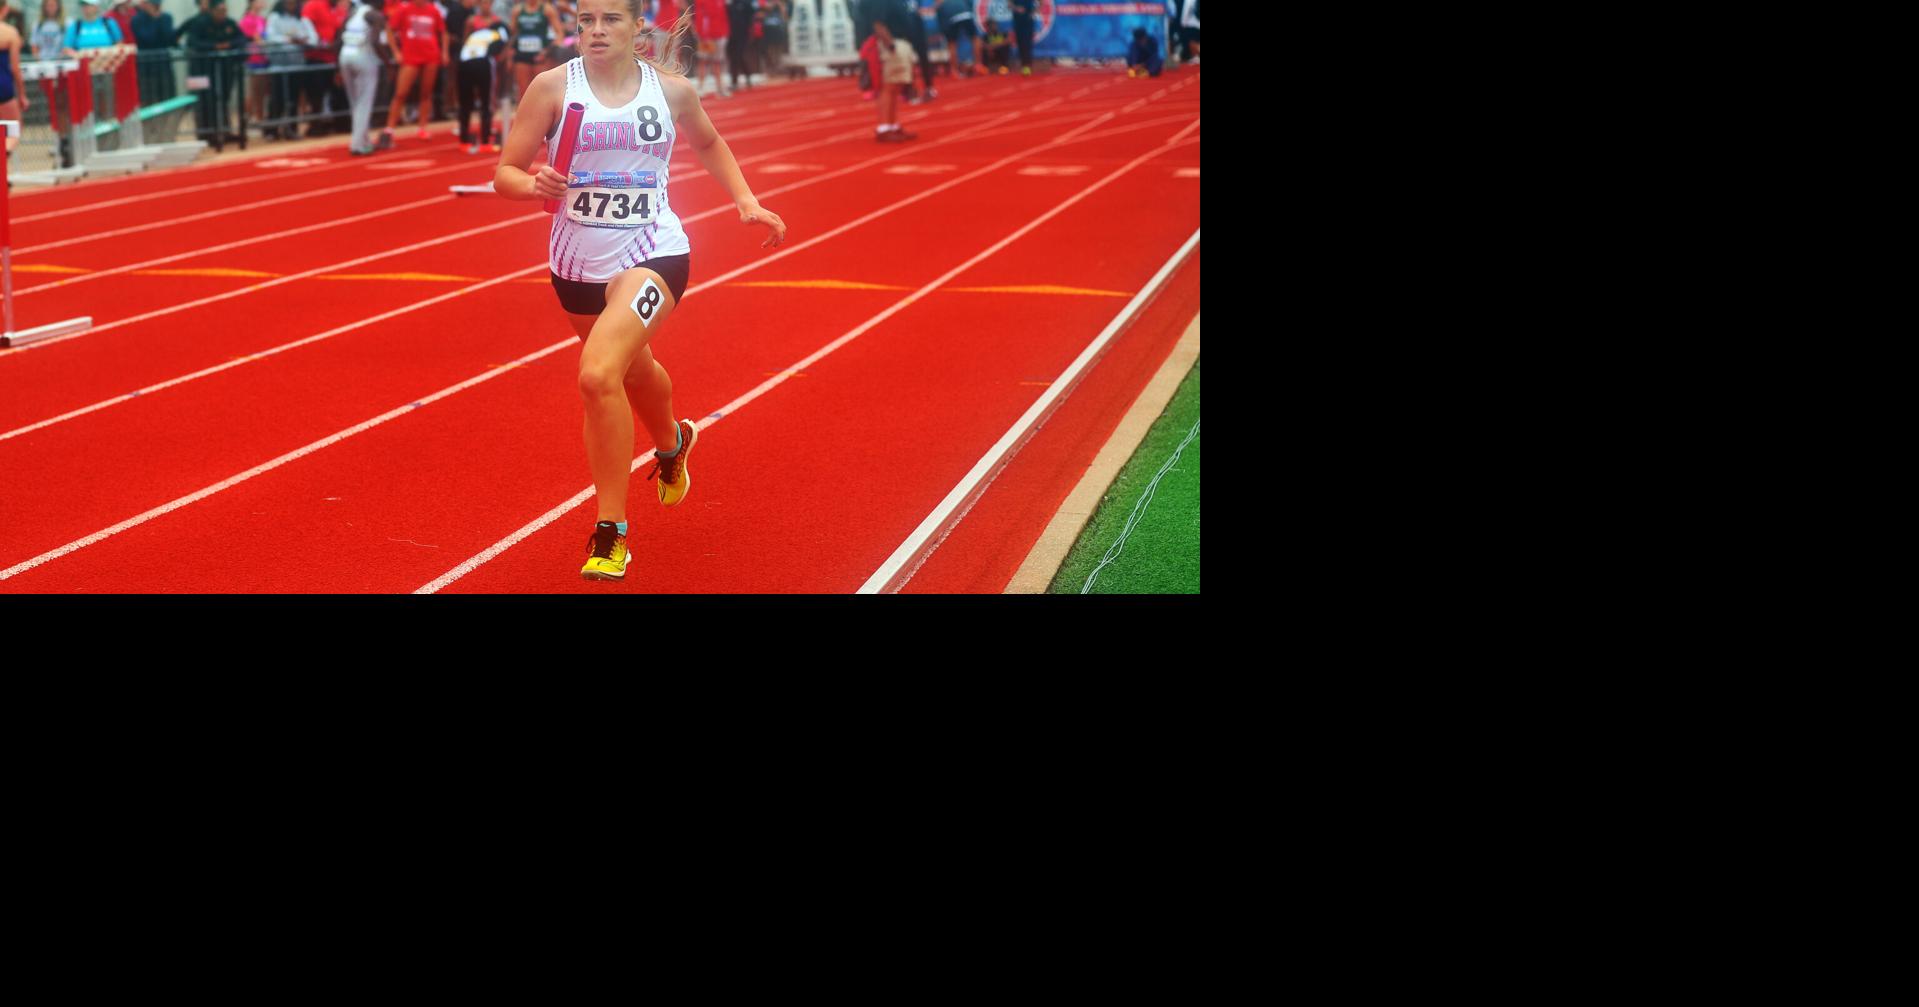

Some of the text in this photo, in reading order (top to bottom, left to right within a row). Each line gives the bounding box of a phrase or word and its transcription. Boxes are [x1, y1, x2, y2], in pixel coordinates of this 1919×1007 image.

[636, 105, 662, 142] 8
[572, 191, 651, 220] 4734
[636, 285, 660, 320] 8
